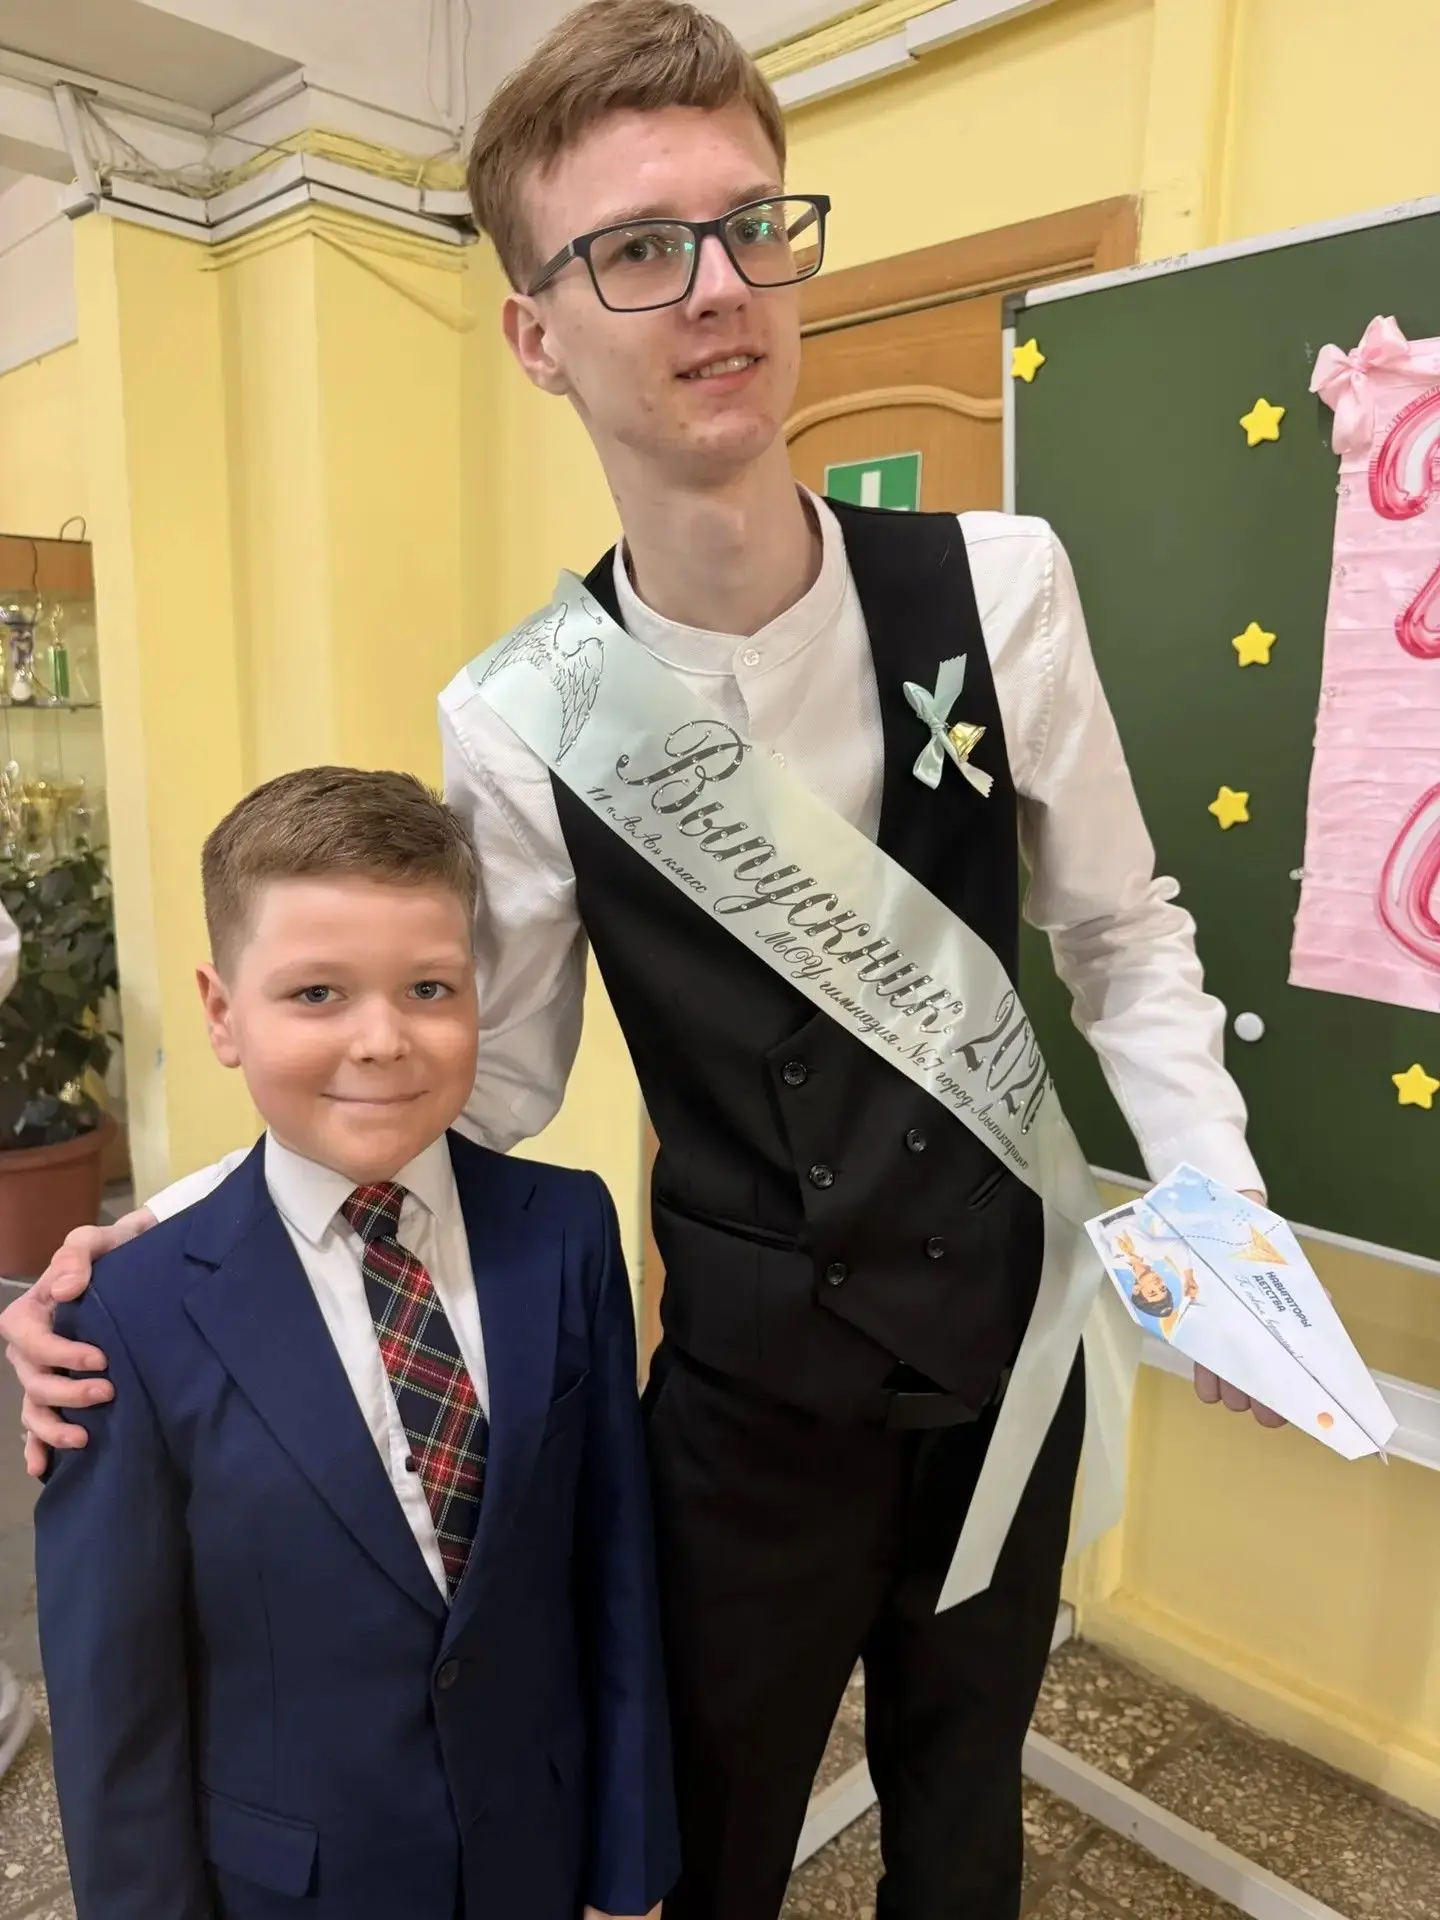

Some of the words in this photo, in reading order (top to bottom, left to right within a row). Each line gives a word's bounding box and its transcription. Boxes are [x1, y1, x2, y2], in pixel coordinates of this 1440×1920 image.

[586, 786, 613, 802] 11
[661, 857, 707, 894] класс
[615, 719, 963, 1036] Выпускник
[755, 931, 832, 979] МОУ
[820, 981, 900, 1045] гимназия
[935, 1071, 974, 1109] город
[1252, 1275, 1286, 1312] ДЕТСТВА
[1265, 1271, 1312, 1328] НАВИГАТОРЫ
